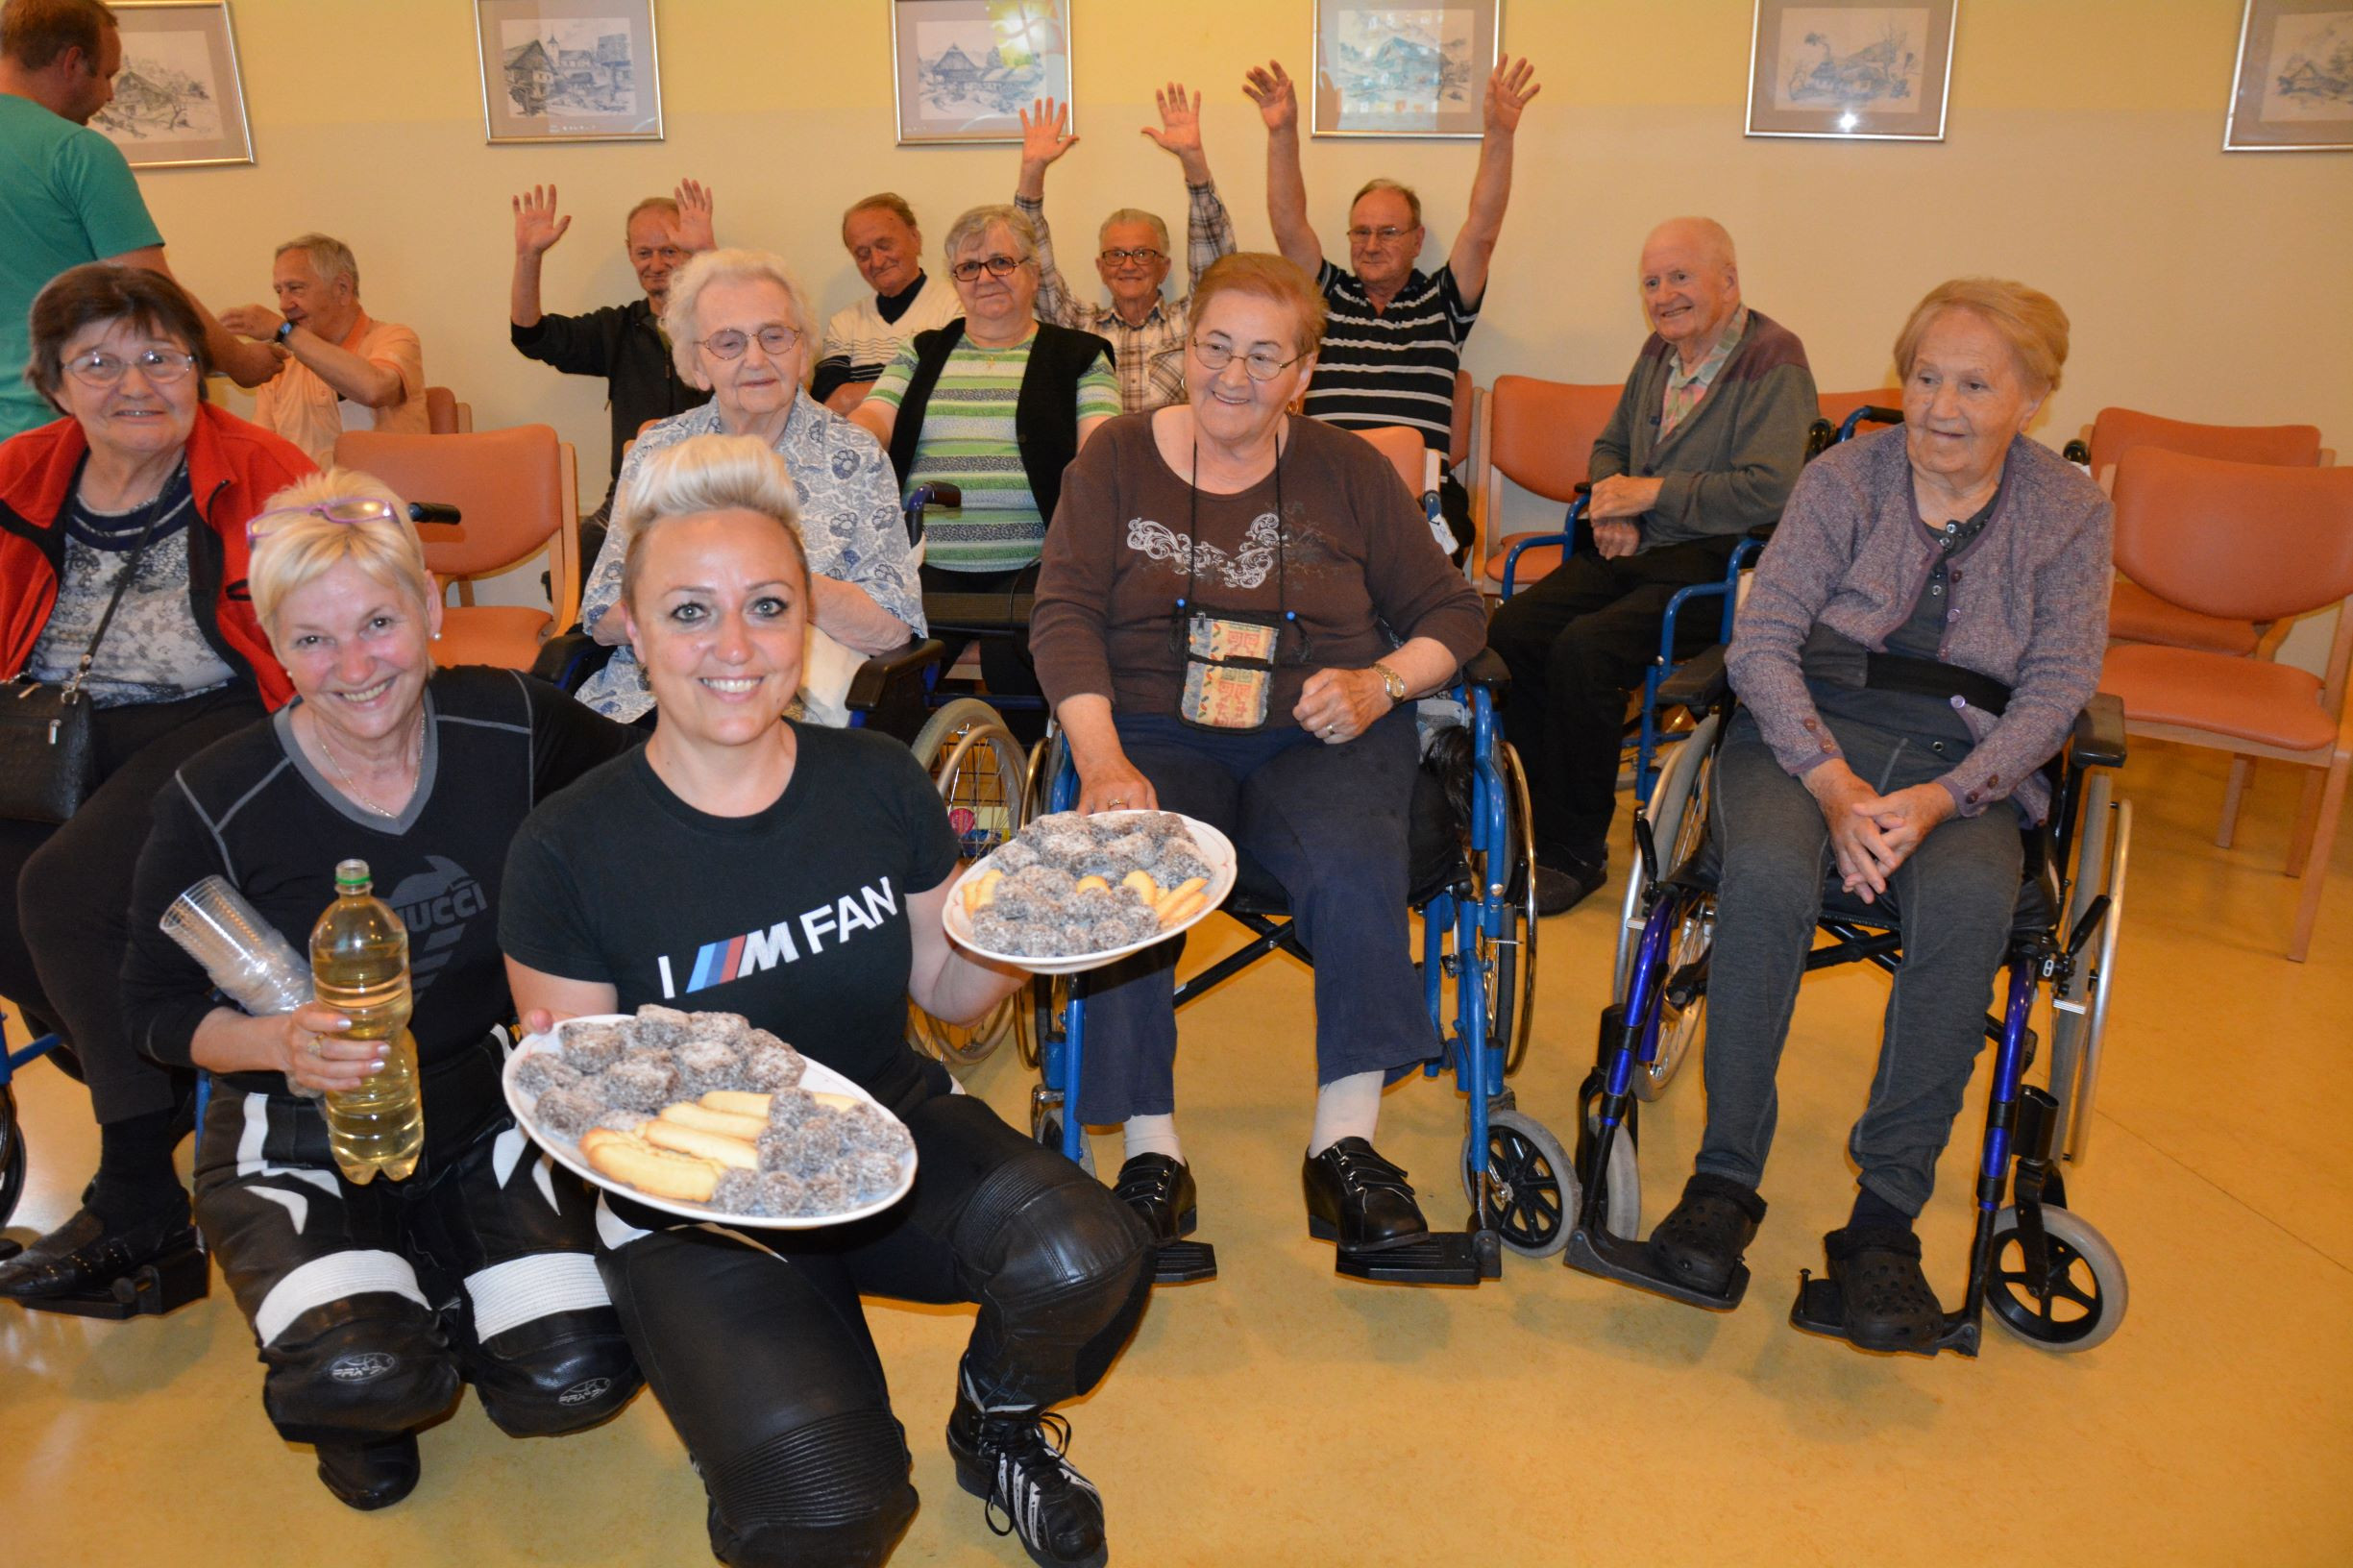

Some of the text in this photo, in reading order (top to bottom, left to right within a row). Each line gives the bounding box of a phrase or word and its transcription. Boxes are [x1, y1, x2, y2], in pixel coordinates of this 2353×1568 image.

[657, 875, 898, 1000] I M FAN
